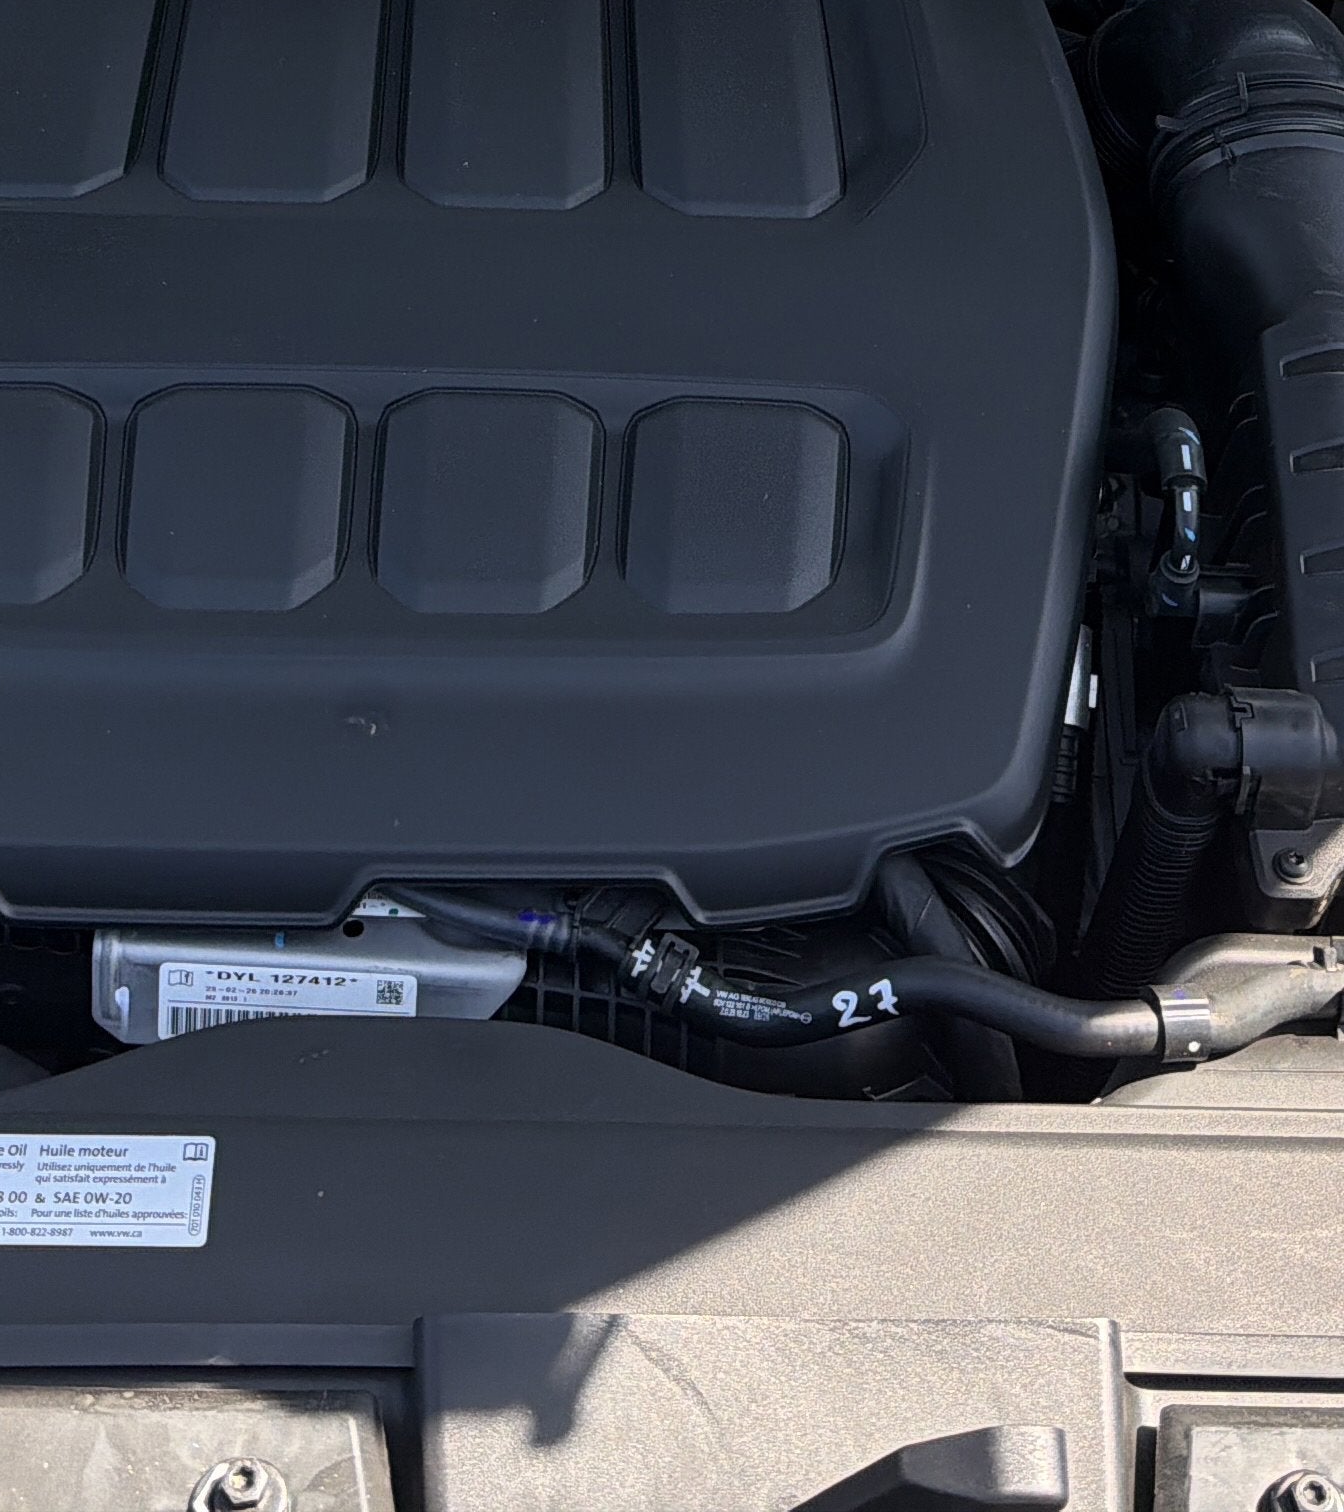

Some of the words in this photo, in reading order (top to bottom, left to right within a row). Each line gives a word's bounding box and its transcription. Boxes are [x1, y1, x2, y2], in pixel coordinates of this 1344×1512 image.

[8, 1143, 27, 1156] Oil
[39, 1144, 75, 1157] Huile
[78, 1145, 129, 1157] moteur
[37, 1162, 72, 1172] Utilisez
[74, 1163, 132, 1174] uniquement
[134, 1163, 146, 1172] de
[148, 1163, 177, 1173] l'huile
[35, 1174, 51, 1185] qui
[53, 1173, 91, 1183] satisfait
[92, 1174, 159, 1185] expressément
[8, 1190, 27, 1203] 00
[34, 1193, 46, 1204] &
[53, 1191, 80, 1204] SAE
[84, 1191, 133, 1205] 0W-20
[31, 1208, 53, 1218] Pour
[55, 1210, 72, 1218] une
[74, 1209, 93, 1219] liste
[94, 1209, 130, 1219] d'huiles
[2, 1227, 73, 1237] 1-800-822-8987
[89, 1230, 143, 1238] www.vw.ca
